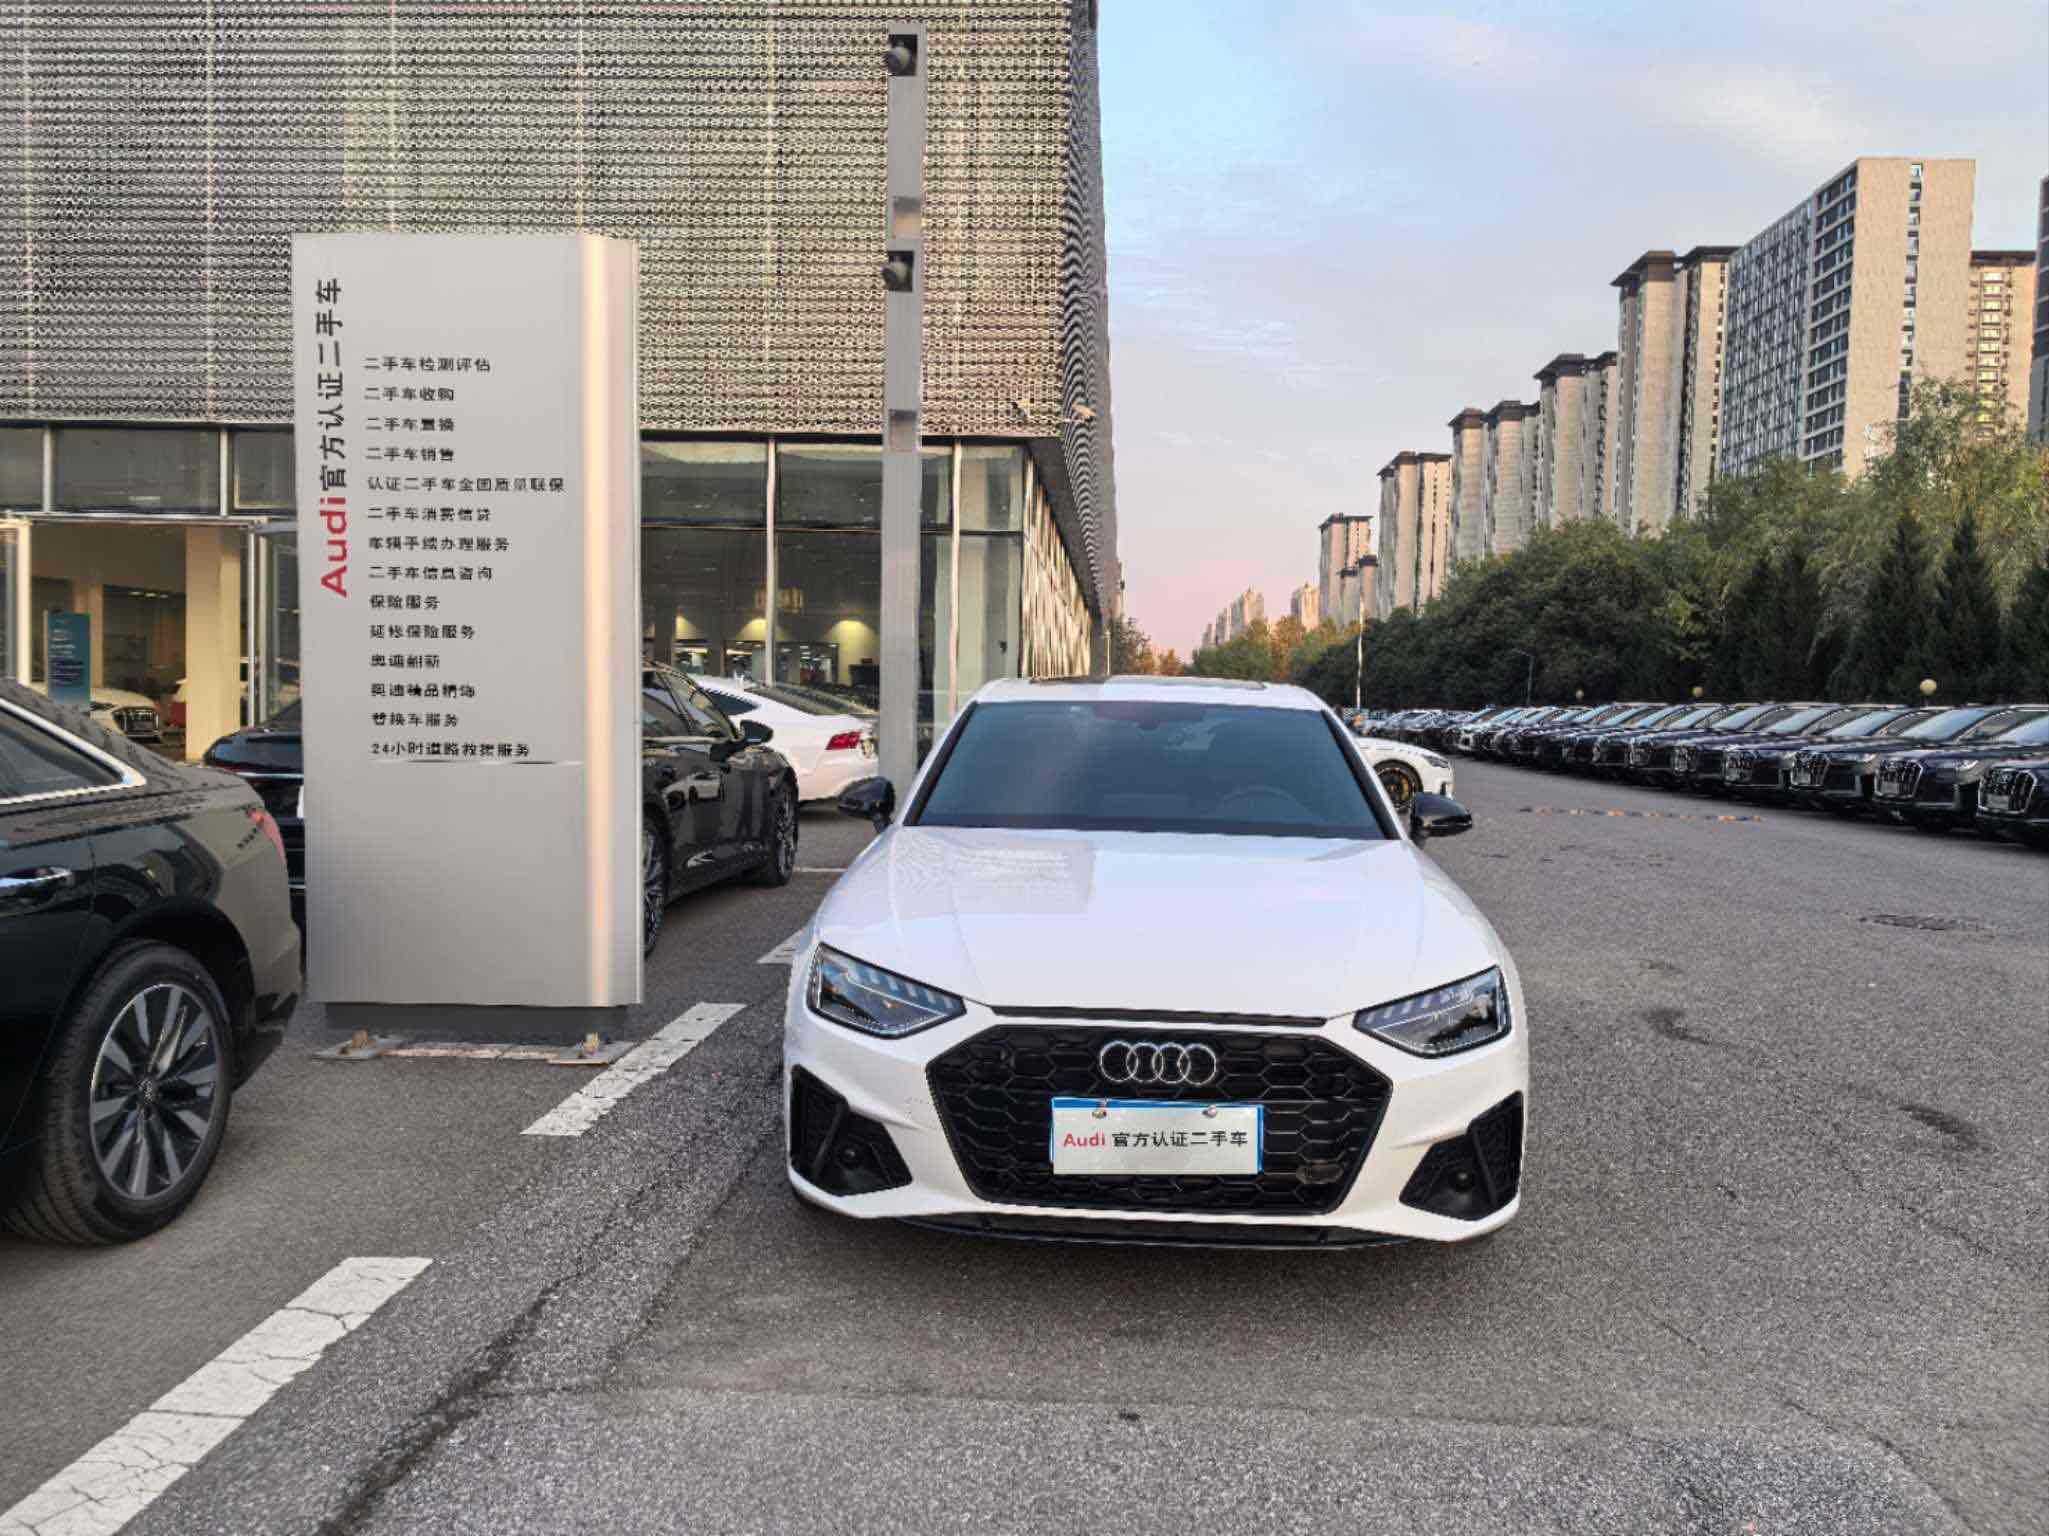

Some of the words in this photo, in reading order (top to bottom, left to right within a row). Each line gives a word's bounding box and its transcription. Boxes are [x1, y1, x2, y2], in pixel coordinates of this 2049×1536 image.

[315, 277, 347, 491] 官方认证二手车
[320, 496, 347, 598] Audi
[1063, 1132, 1106, 1147] Audi
[1111, 1130, 1249, 1148] 官方认证二手车
